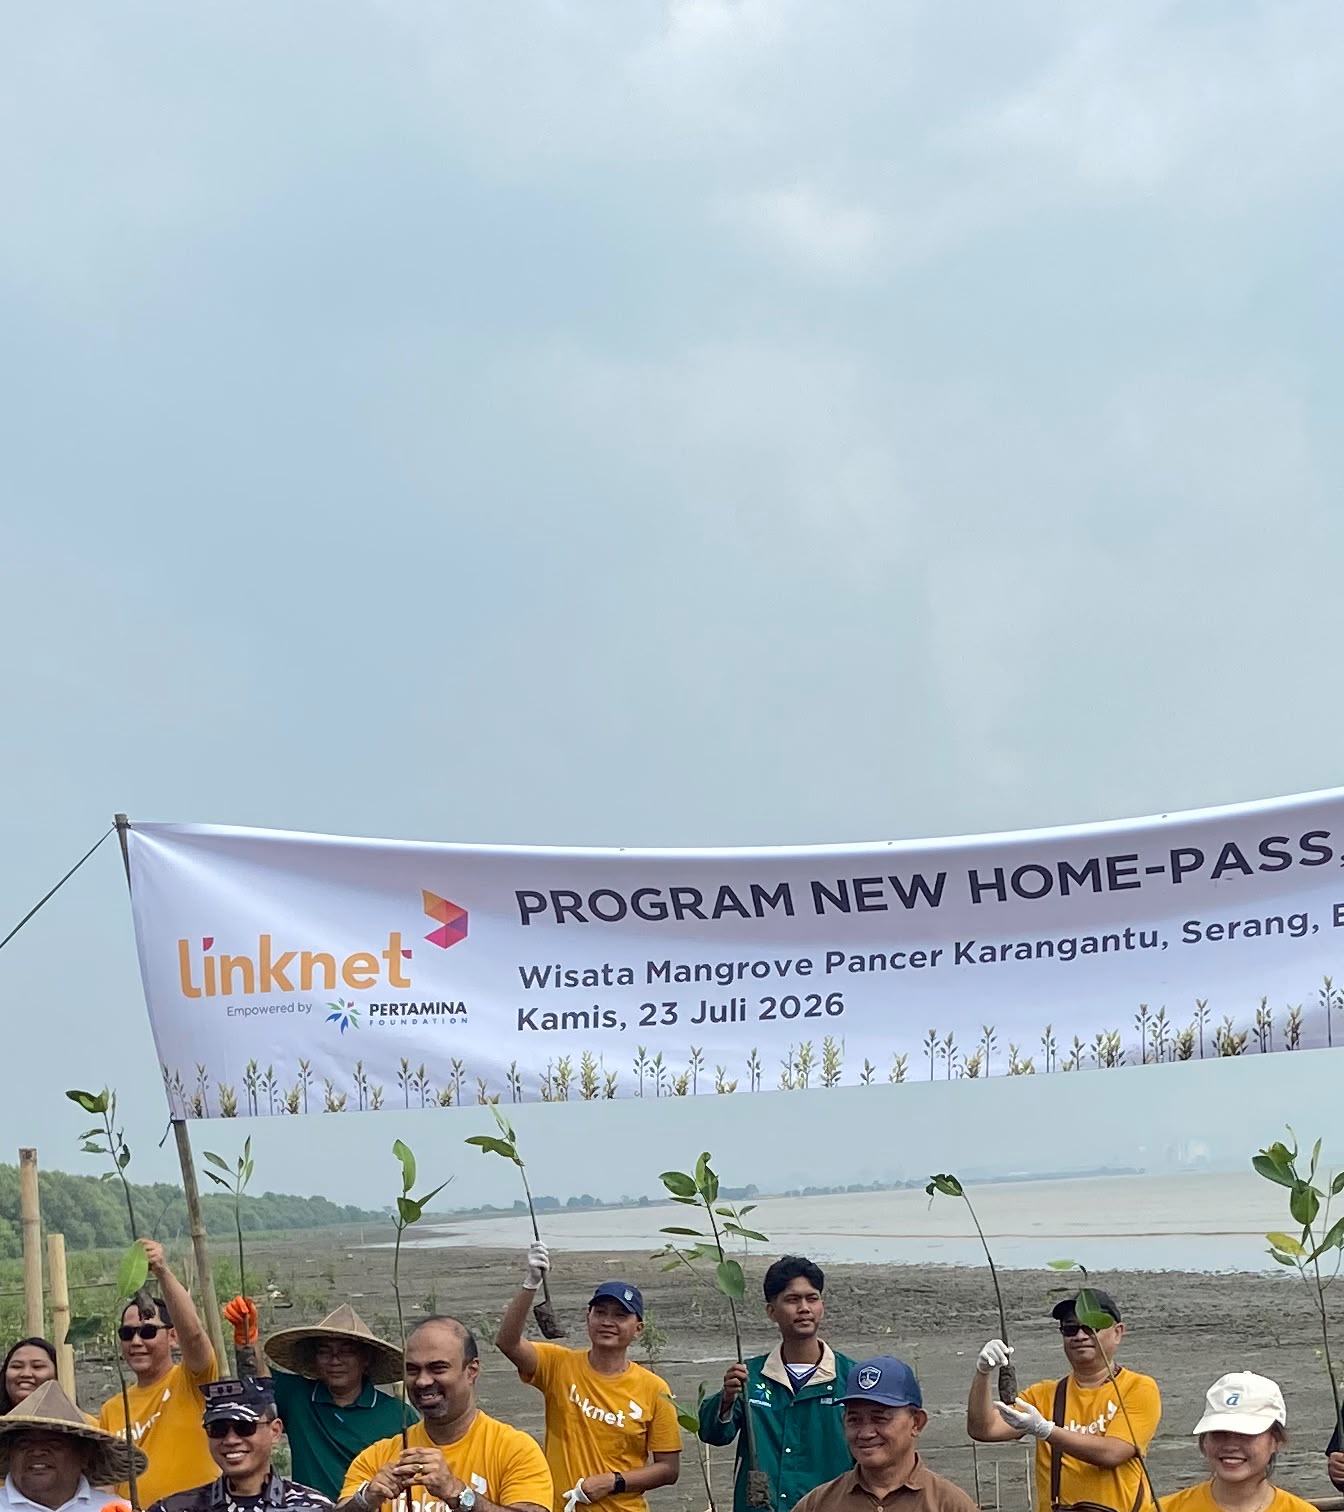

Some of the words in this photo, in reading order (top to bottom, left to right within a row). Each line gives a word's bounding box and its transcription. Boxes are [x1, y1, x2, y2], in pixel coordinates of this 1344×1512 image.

[515, 882, 795, 926] PROGRAM
[810, 871, 948, 915] NEW
[178, 932, 412, 998] linknet
[518, 963, 634, 989] Wisata
[646, 958, 813, 986] Mangrove
[825, 949, 943, 975] Pancer
[954, 927, 1169, 966] Karangantu,
[1182, 912, 1319, 944] Serang,
[227, 1002, 295, 1017] Empowered
[297, 1002, 313, 1015] by
[369, 1001, 467, 1017] PERTAMINA
[369, 1017, 468, 1026] FOUNDATION
[517, 1004, 627, 1032] Kamis,
[638, 1001, 678, 1027] 23
[690, 997, 746, 1024] Juli
[758, 992, 844, 1021] 2026
